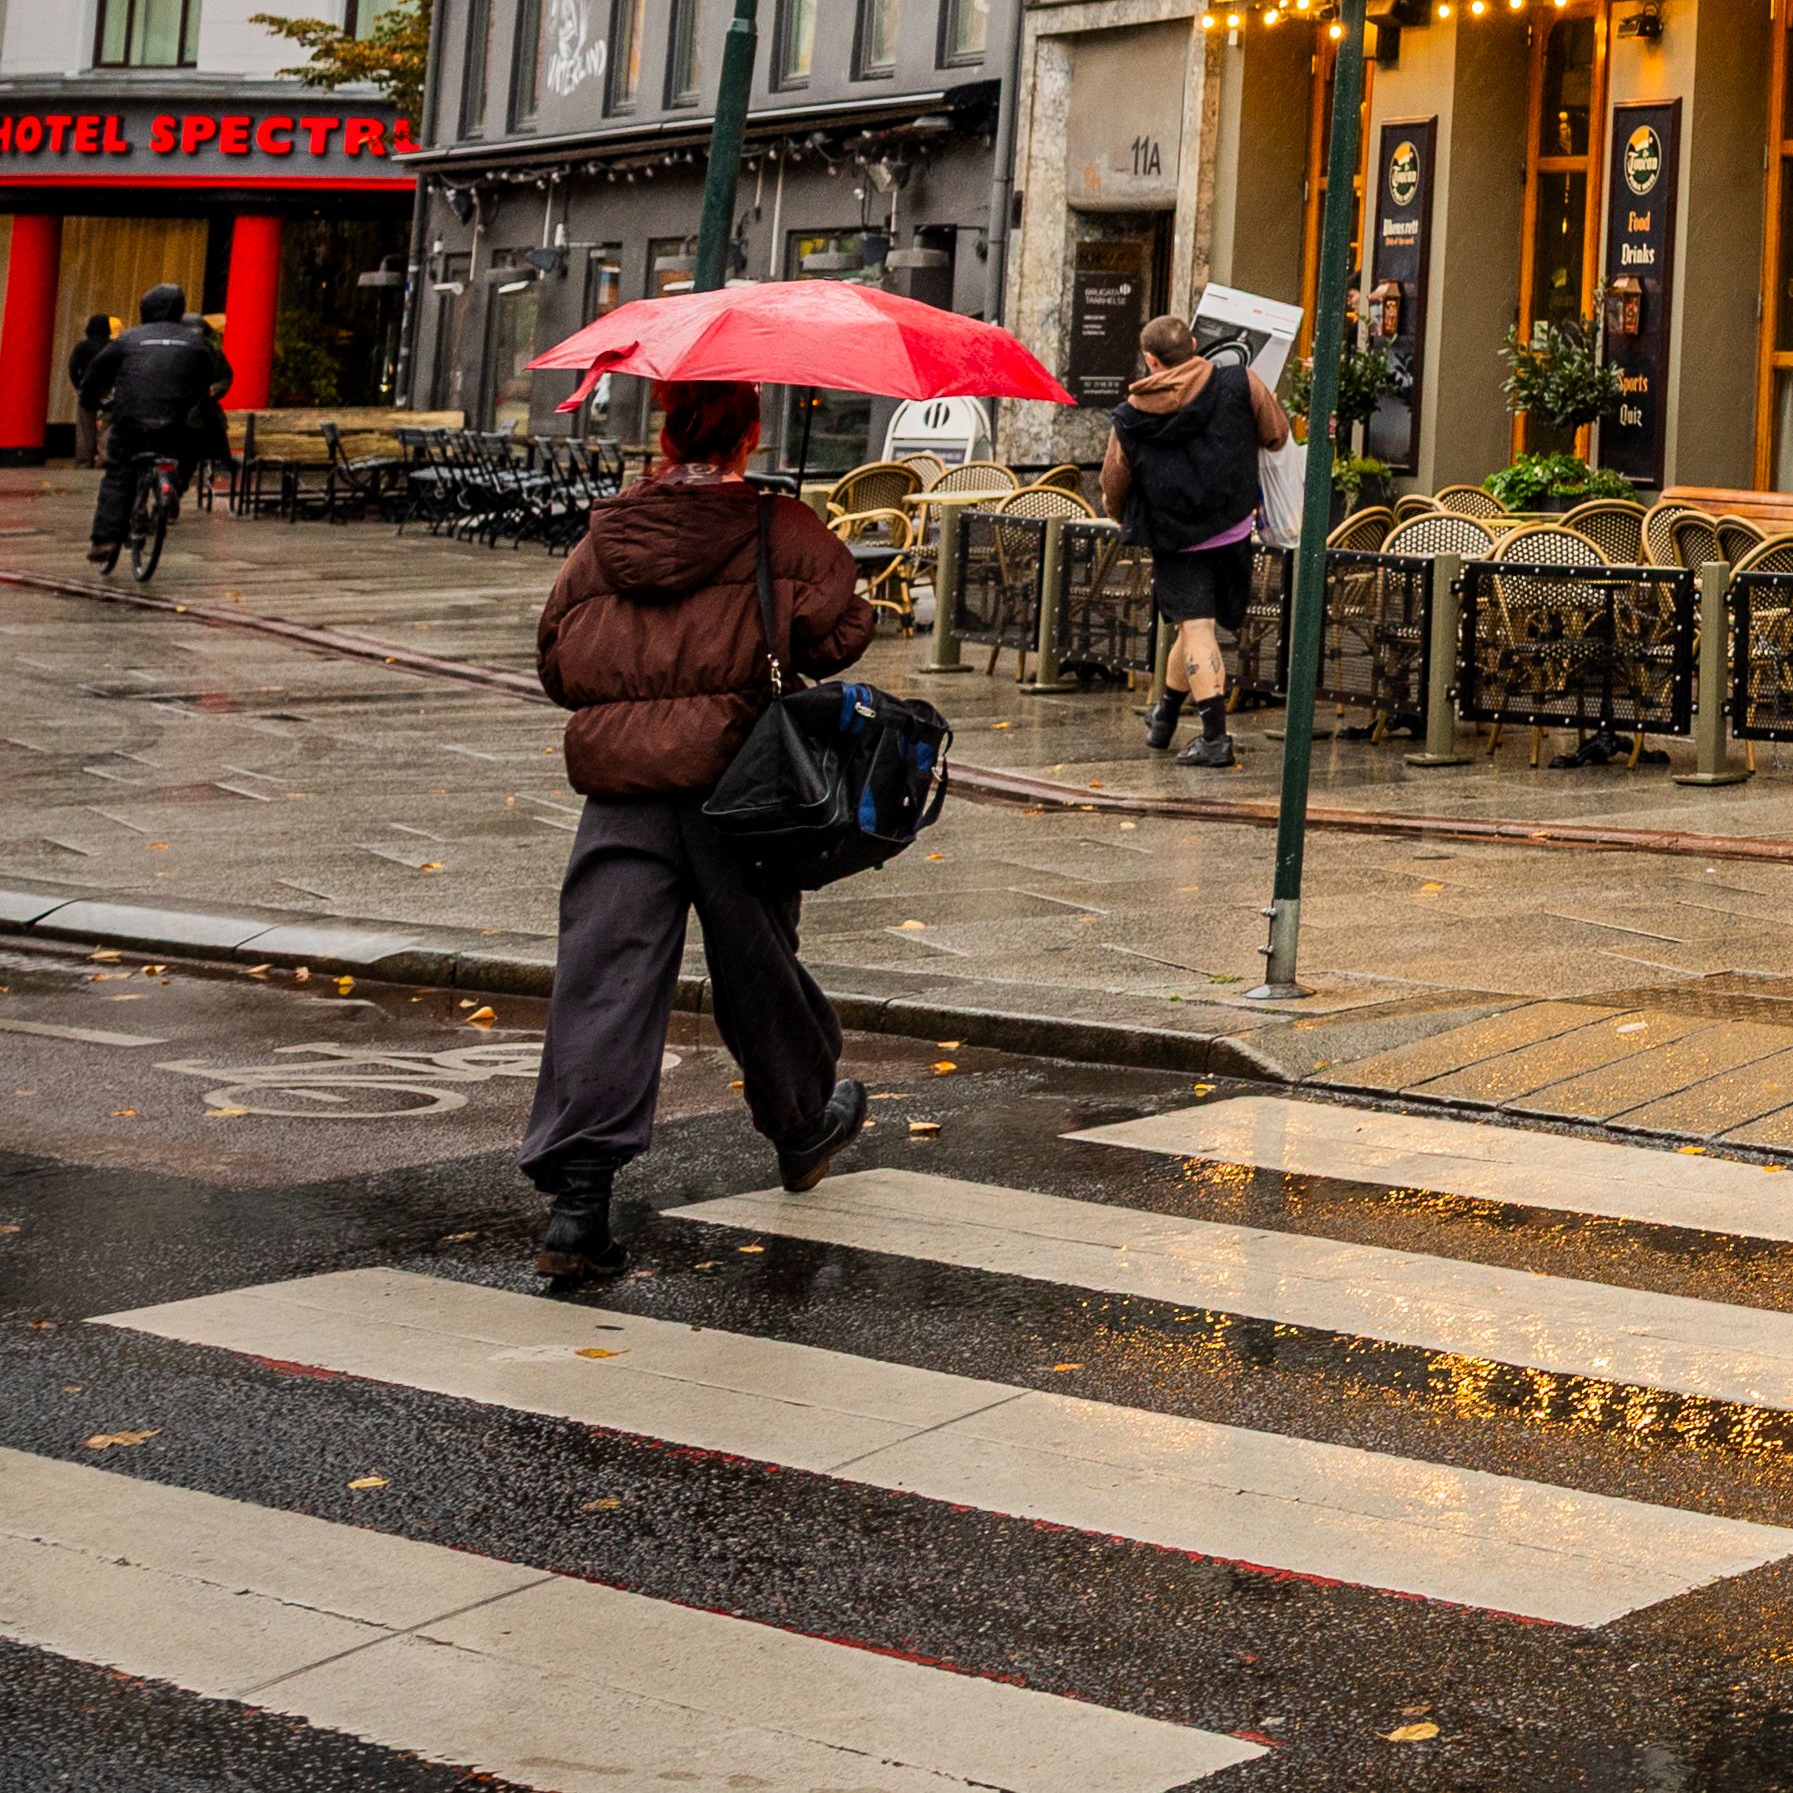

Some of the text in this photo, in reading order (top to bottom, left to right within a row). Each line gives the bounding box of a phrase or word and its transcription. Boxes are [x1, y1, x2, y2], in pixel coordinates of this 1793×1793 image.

[149, 114, 421, 157] SPECTR
[1131, 135, 1161, 176] 11A
[1628, 210, 1651, 233] Food
[1621, 243, 1656, 266] Drinks
[1617, 373, 1648, 397] Sports
[1620, 403, 1643, 428] Quiz
